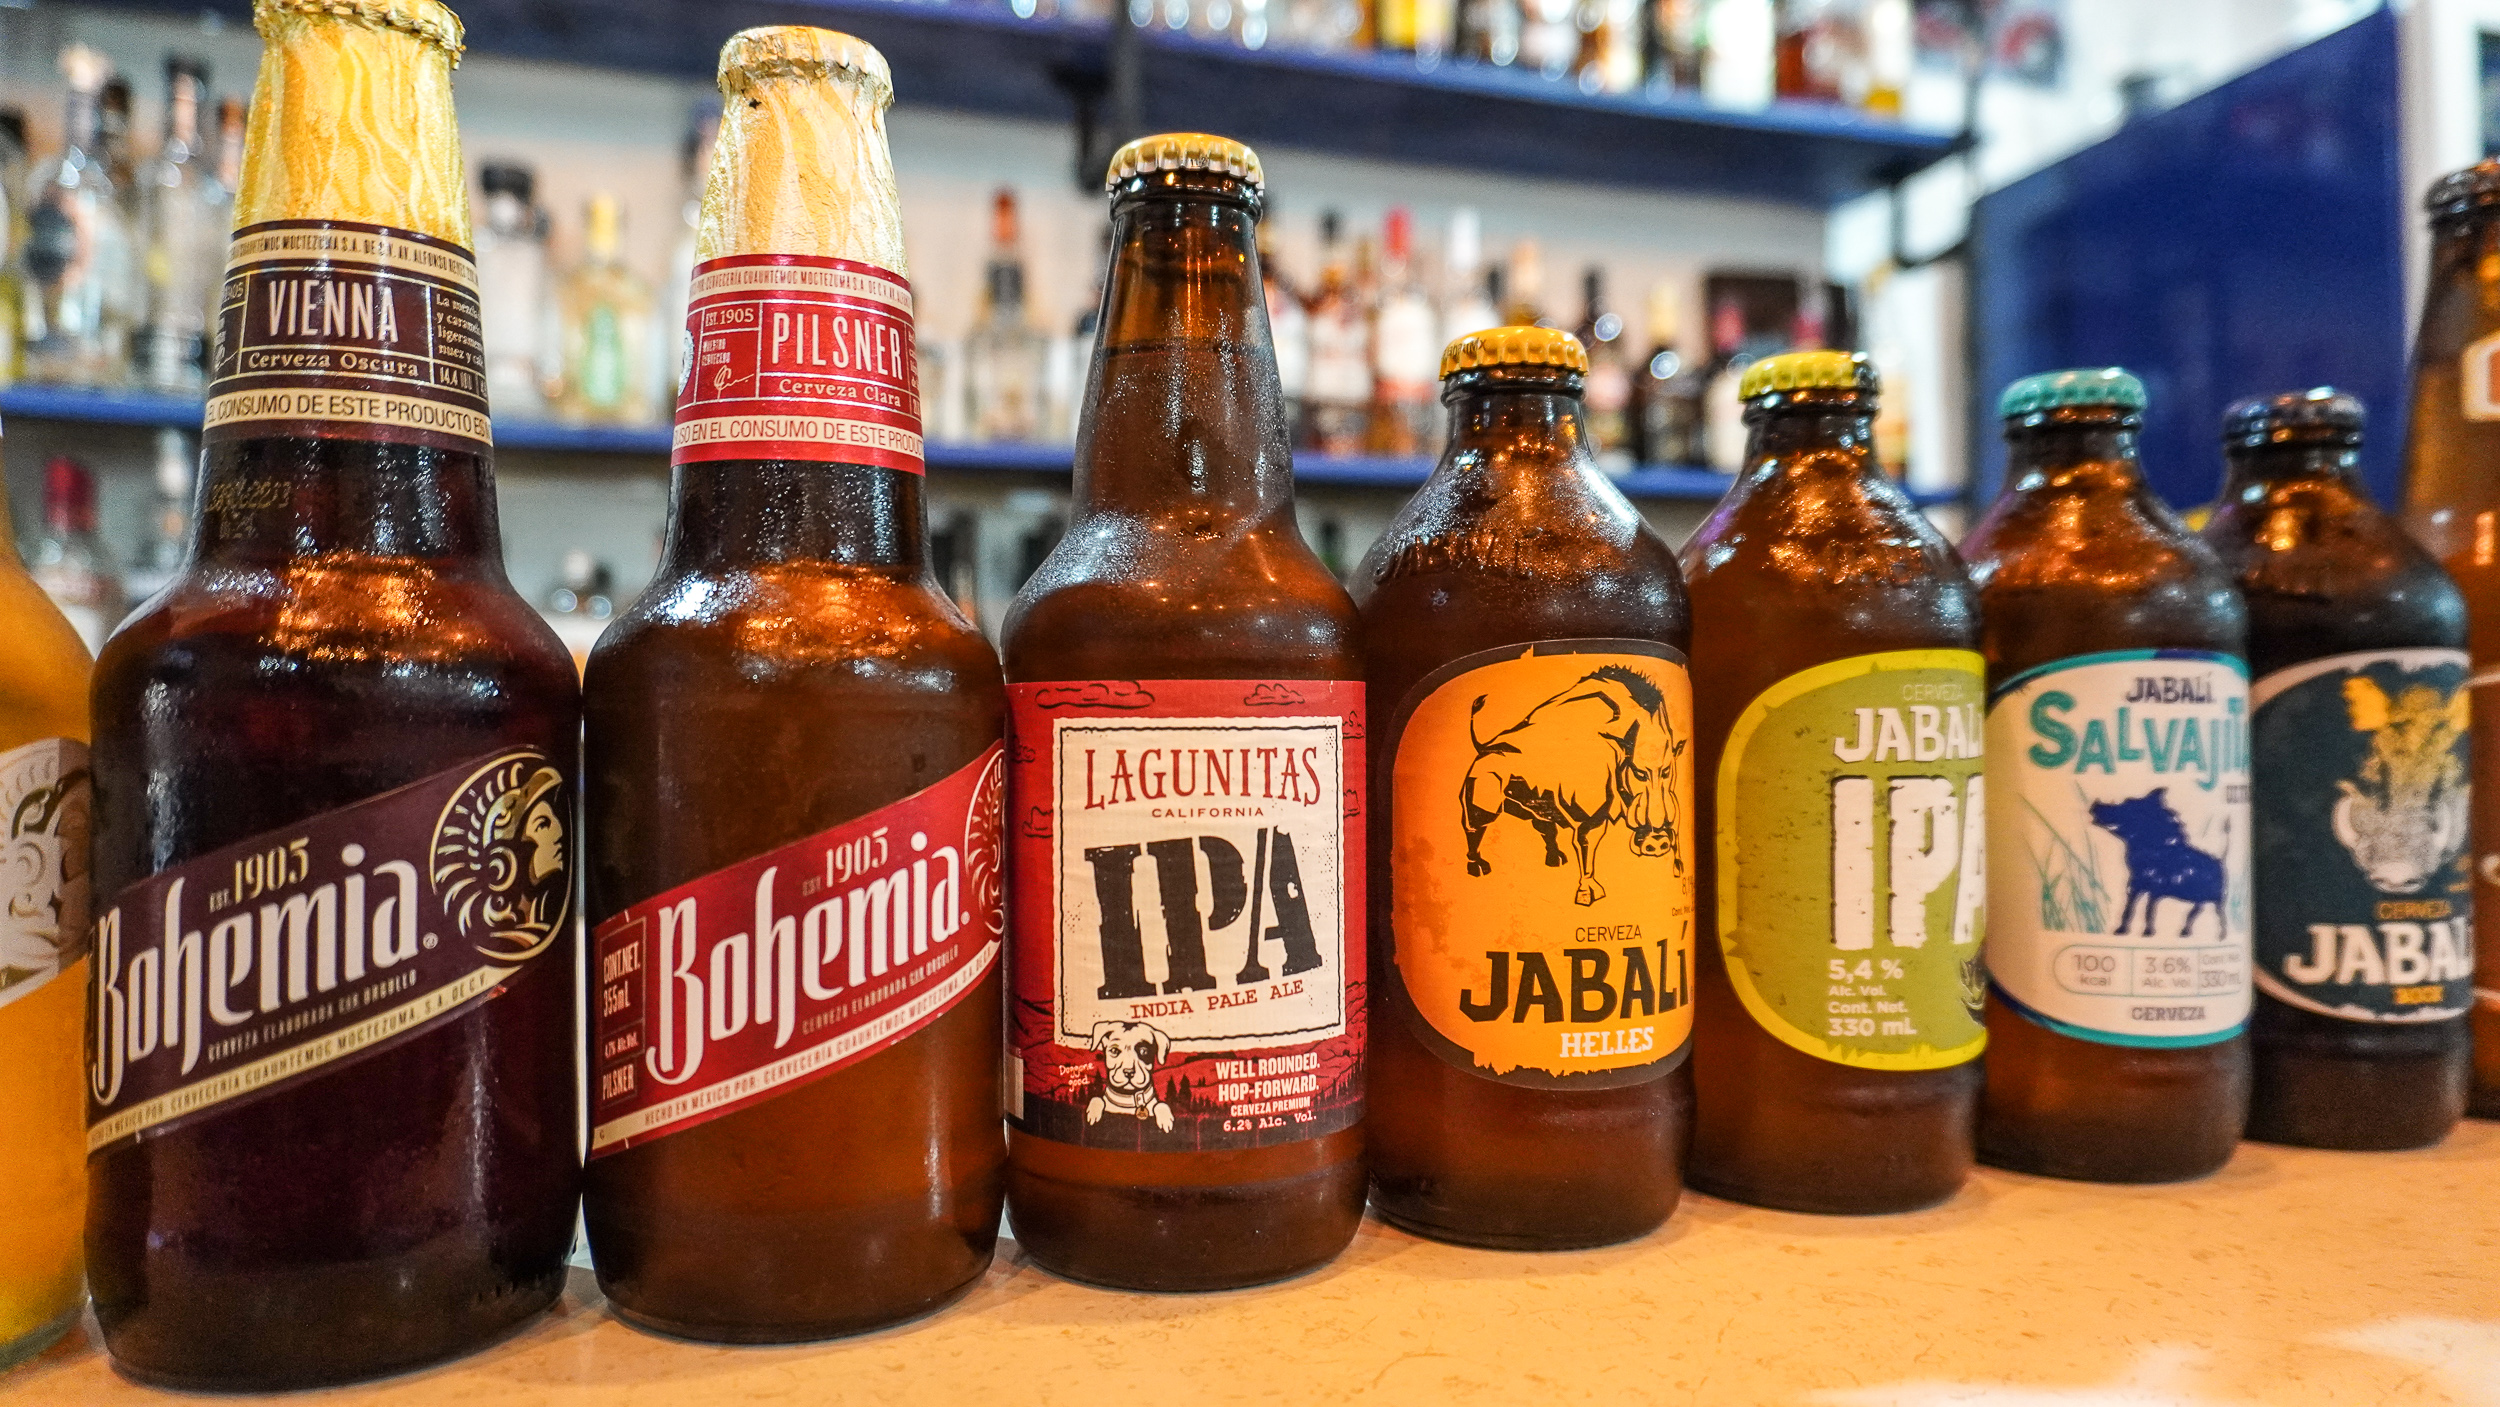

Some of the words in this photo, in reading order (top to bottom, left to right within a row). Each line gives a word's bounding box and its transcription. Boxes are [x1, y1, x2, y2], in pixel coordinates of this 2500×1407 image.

[364, 239, 376, 254] DE
[800, 271, 851, 290] MOCTEZUMA
[269, 280, 398, 342] VIENNA
[720, 308, 754, 325] 1905
[772, 312, 903, 381] PILSNER
[248, 352, 331, 370] Cerveza
[340, 352, 419, 377] Oscura
[779, 378, 857, 399] Cerveza
[864, 385, 901, 407] Clara
[218, 394, 291, 420] CONSUMO
[296, 394, 324, 415] DE
[329, 395, 380, 419] ESTE
[386, 399, 472, 433] PRODUCTO
[692, 423, 707, 442] EN
[710, 421, 726, 440] EL
[730, 420, 818, 438] CONSUMO
[824, 422, 845, 440] DE
[850, 424, 885, 446] ESTE
[1902, 684, 1963, 701] CERVEZA
[1083, 745, 1322, 811] LAGUNITAS
[1151, 807, 1264, 819] CALIFORNIA
[235, 836, 310, 904] 1905
[826, 826, 888, 888] 1905
[1083, 824, 1323, 1000] IPA
[1575, 924, 1643, 942] CERVEZA
[646, 831, 960, 1085] Bohemia
[1827, 958, 1874, 984] 5,4
[1880, 959, 1905, 980] %
[2074, 954, 2116, 973] 100
[2144, 956, 2192, 974] 3.6%
[92, 843, 419, 1106] Bohemia
[1459, 920, 1689, 1024] JABALÍ
[2079, 973, 2112, 986] kcal
[2201, 970, 2227, 989] 330
[1130, 998, 1192, 1020] INDIA
[1207, 988, 1257, 1011] PALE
[1269, 979, 1304, 1001] ALE
[1828, 984, 1857, 997] Alc.
[1860, 984, 1887, 997] Vol.
[1828, 1001, 1873, 1014] Cont.
[1876, 1000, 1909, 1013] Net.
[2131, 1006, 2206, 1021] CERVEZA
[1827, 1018, 1875, 1037] 330
[1882, 1016, 1918, 1036] mL
[208, 1028, 259, 1062] CERVEZA
[1559, 1026, 1654, 1058] HELLES
[1215, 1059, 1256, 1080] WELL
[1258, 1052, 1320, 1077] ROUNDED.
[602, 1063, 634, 1101] PILSNER
[1068, 1074, 1090, 1092] good
[1218, 1074, 1320, 1102] HOP-FORWARD.
[1230, 1101, 1270, 1117] CERVEZA
[1272, 1096, 1311, 1113] PREMIUM
[1223, 1119, 1253, 1132] 6.2%
[1258, 1116, 1287, 1129] Alc.
[1294, 1110, 1317, 1124] Vol.
